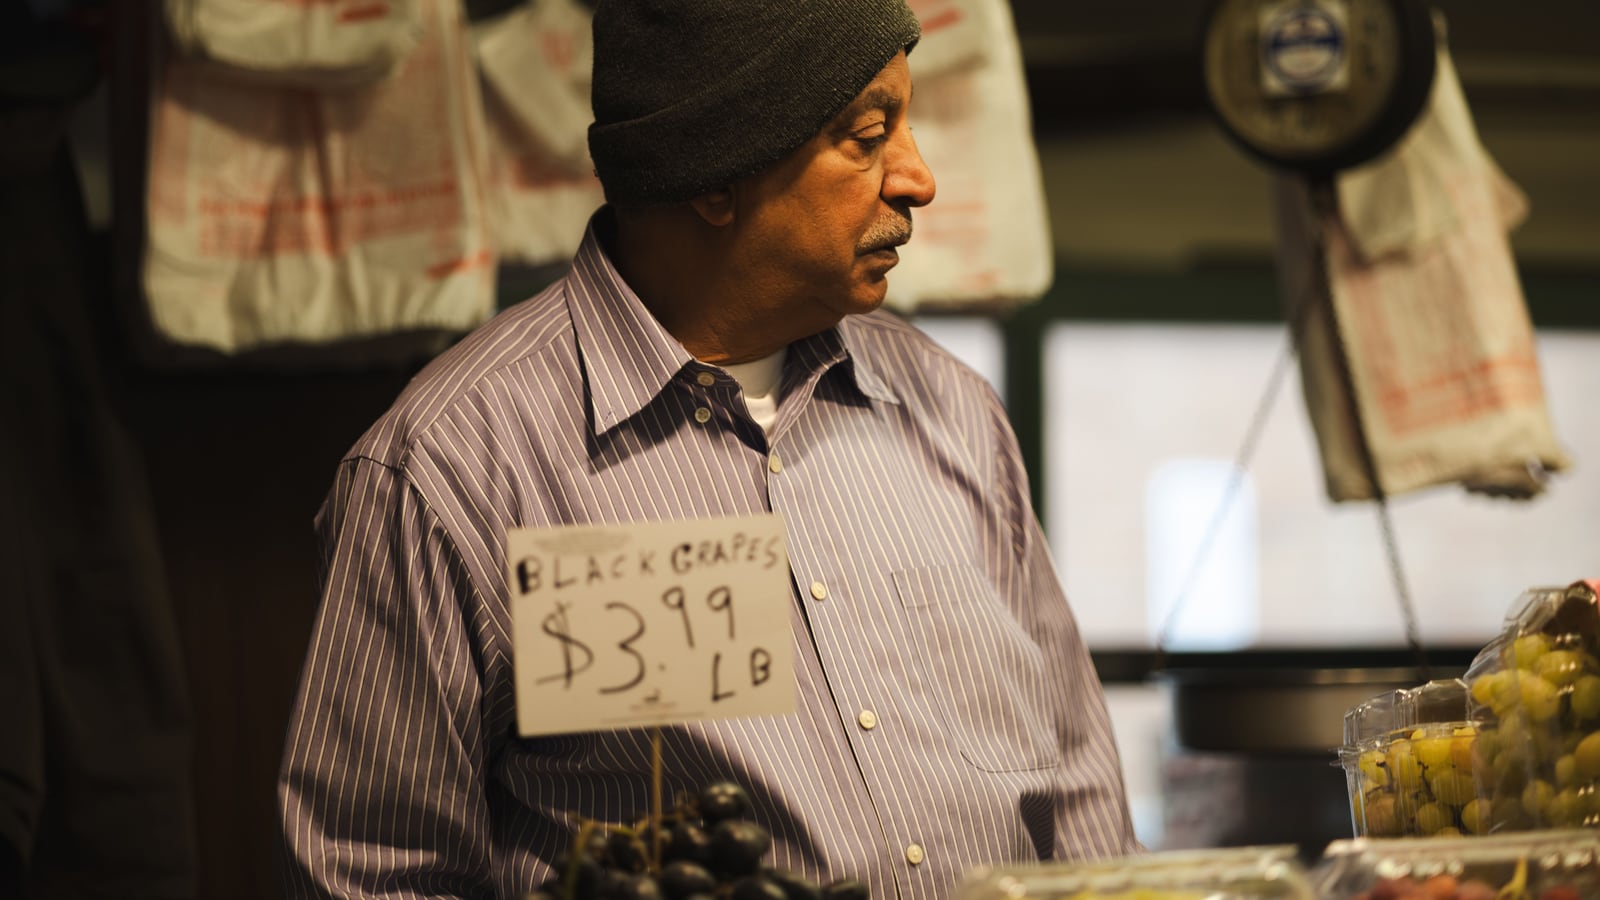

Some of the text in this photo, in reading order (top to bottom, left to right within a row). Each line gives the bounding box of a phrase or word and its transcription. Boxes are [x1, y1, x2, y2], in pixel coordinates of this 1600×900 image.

[516, 532, 780, 595] BLACK GRAPES
[711, 647, 772, 703] LB
